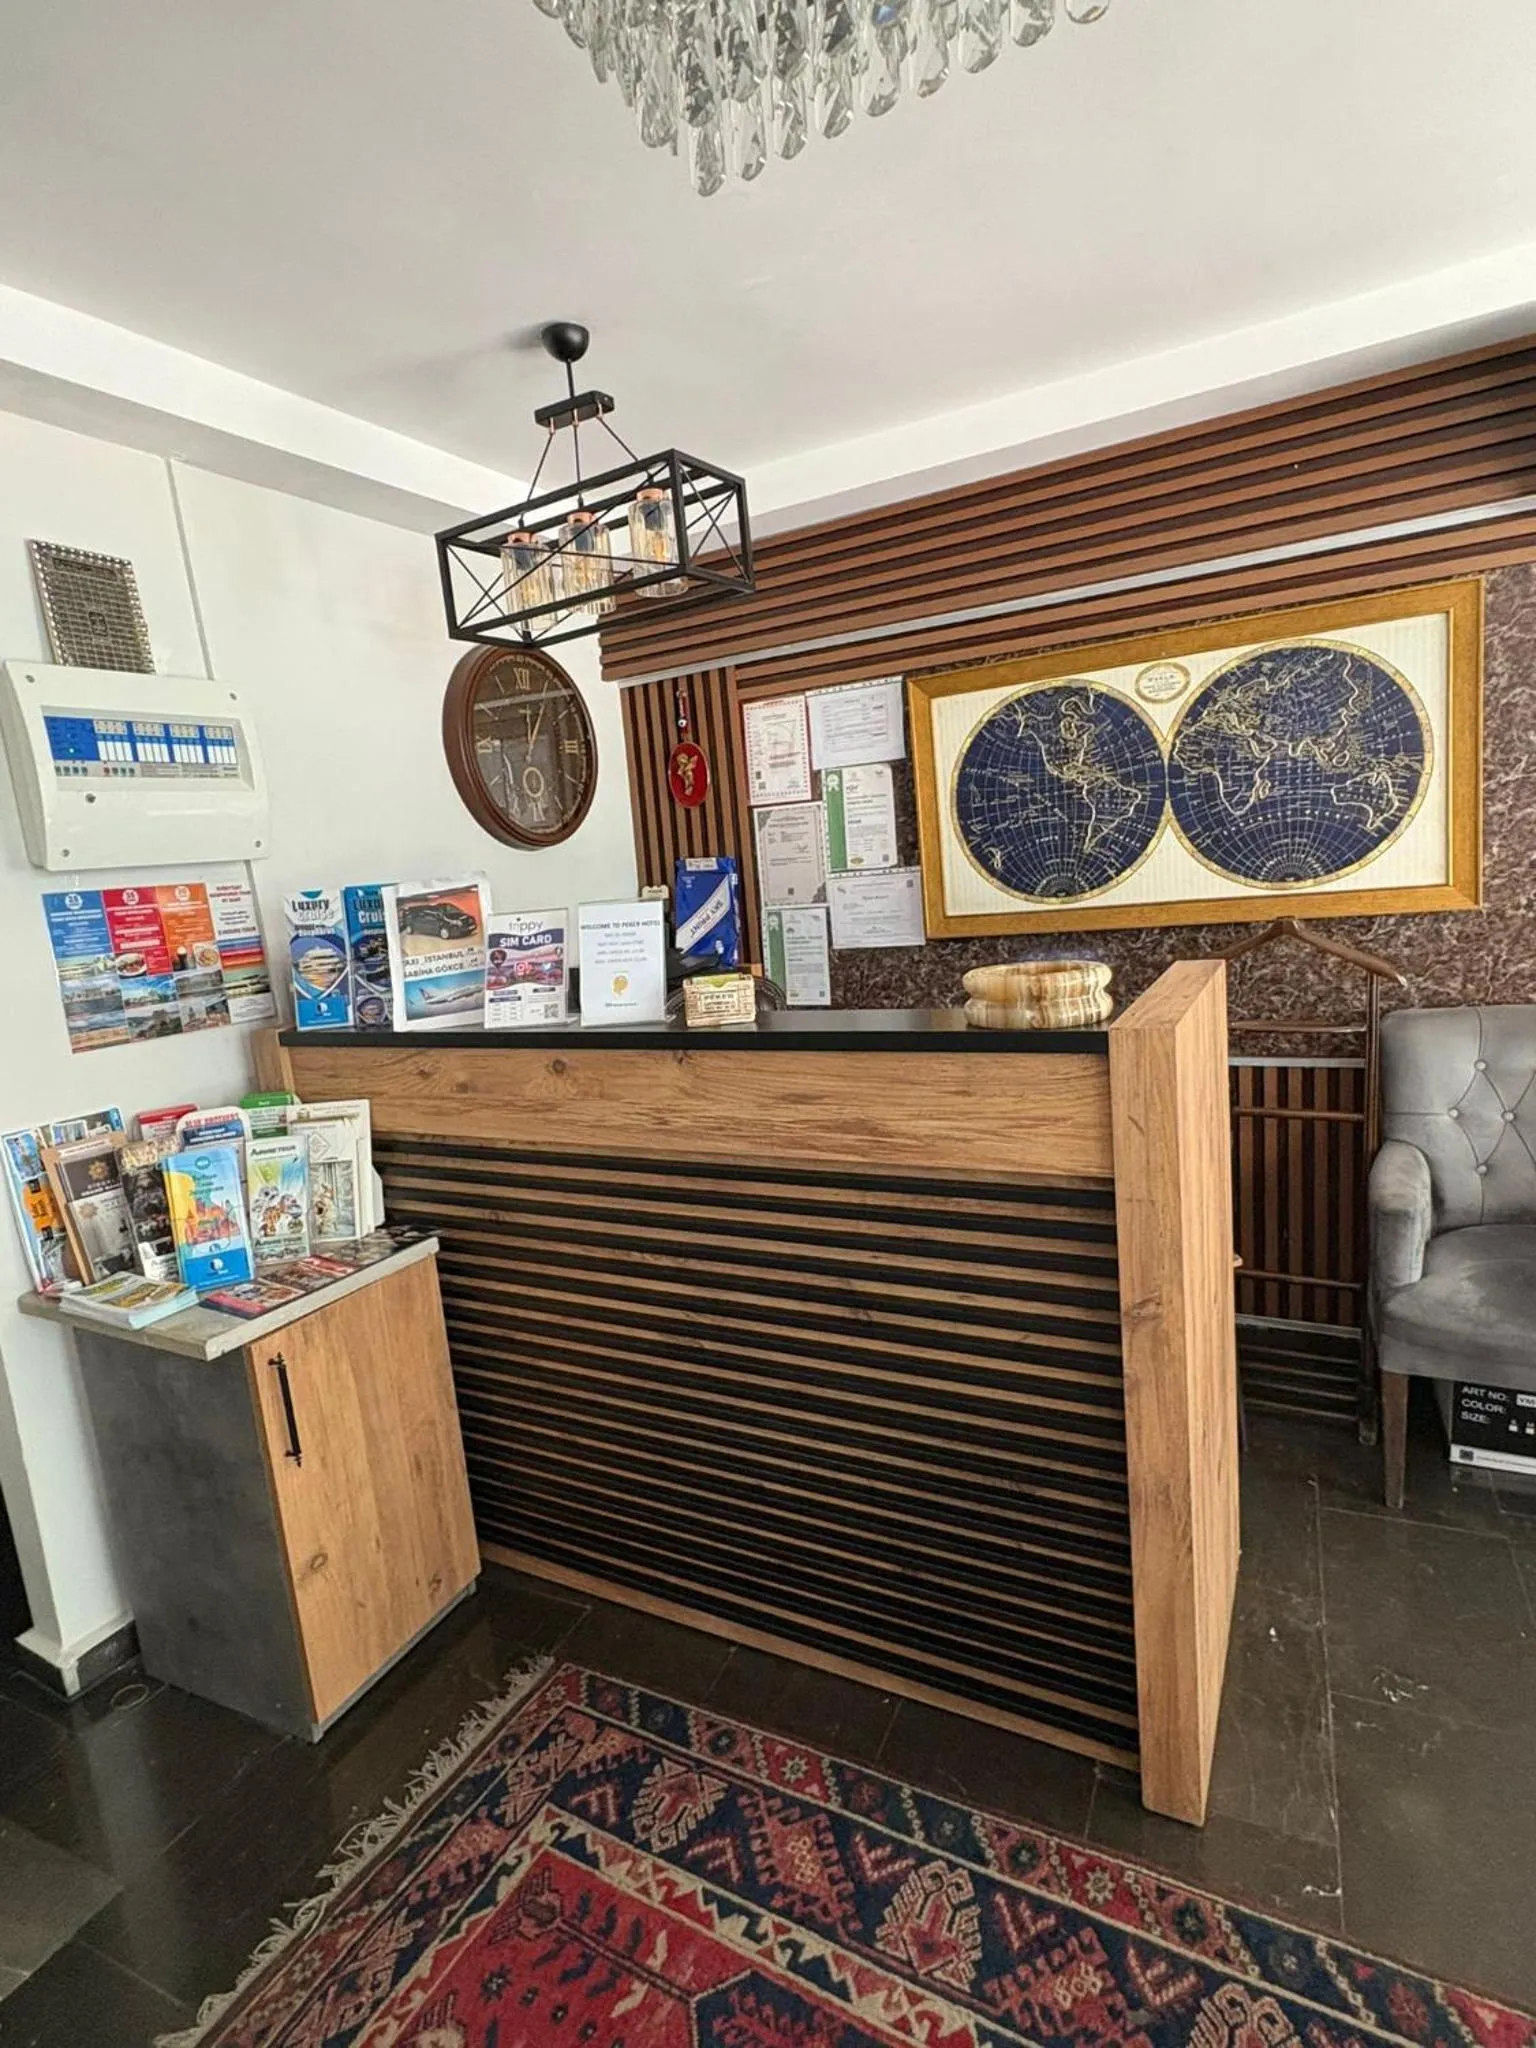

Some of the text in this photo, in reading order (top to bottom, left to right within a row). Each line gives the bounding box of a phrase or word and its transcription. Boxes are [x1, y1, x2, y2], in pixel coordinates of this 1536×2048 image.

[291, 899, 330, 912] Luxury
[500, 934, 552, 947] SIM CARD
[1462, 1385, 1486, 1397] ART
